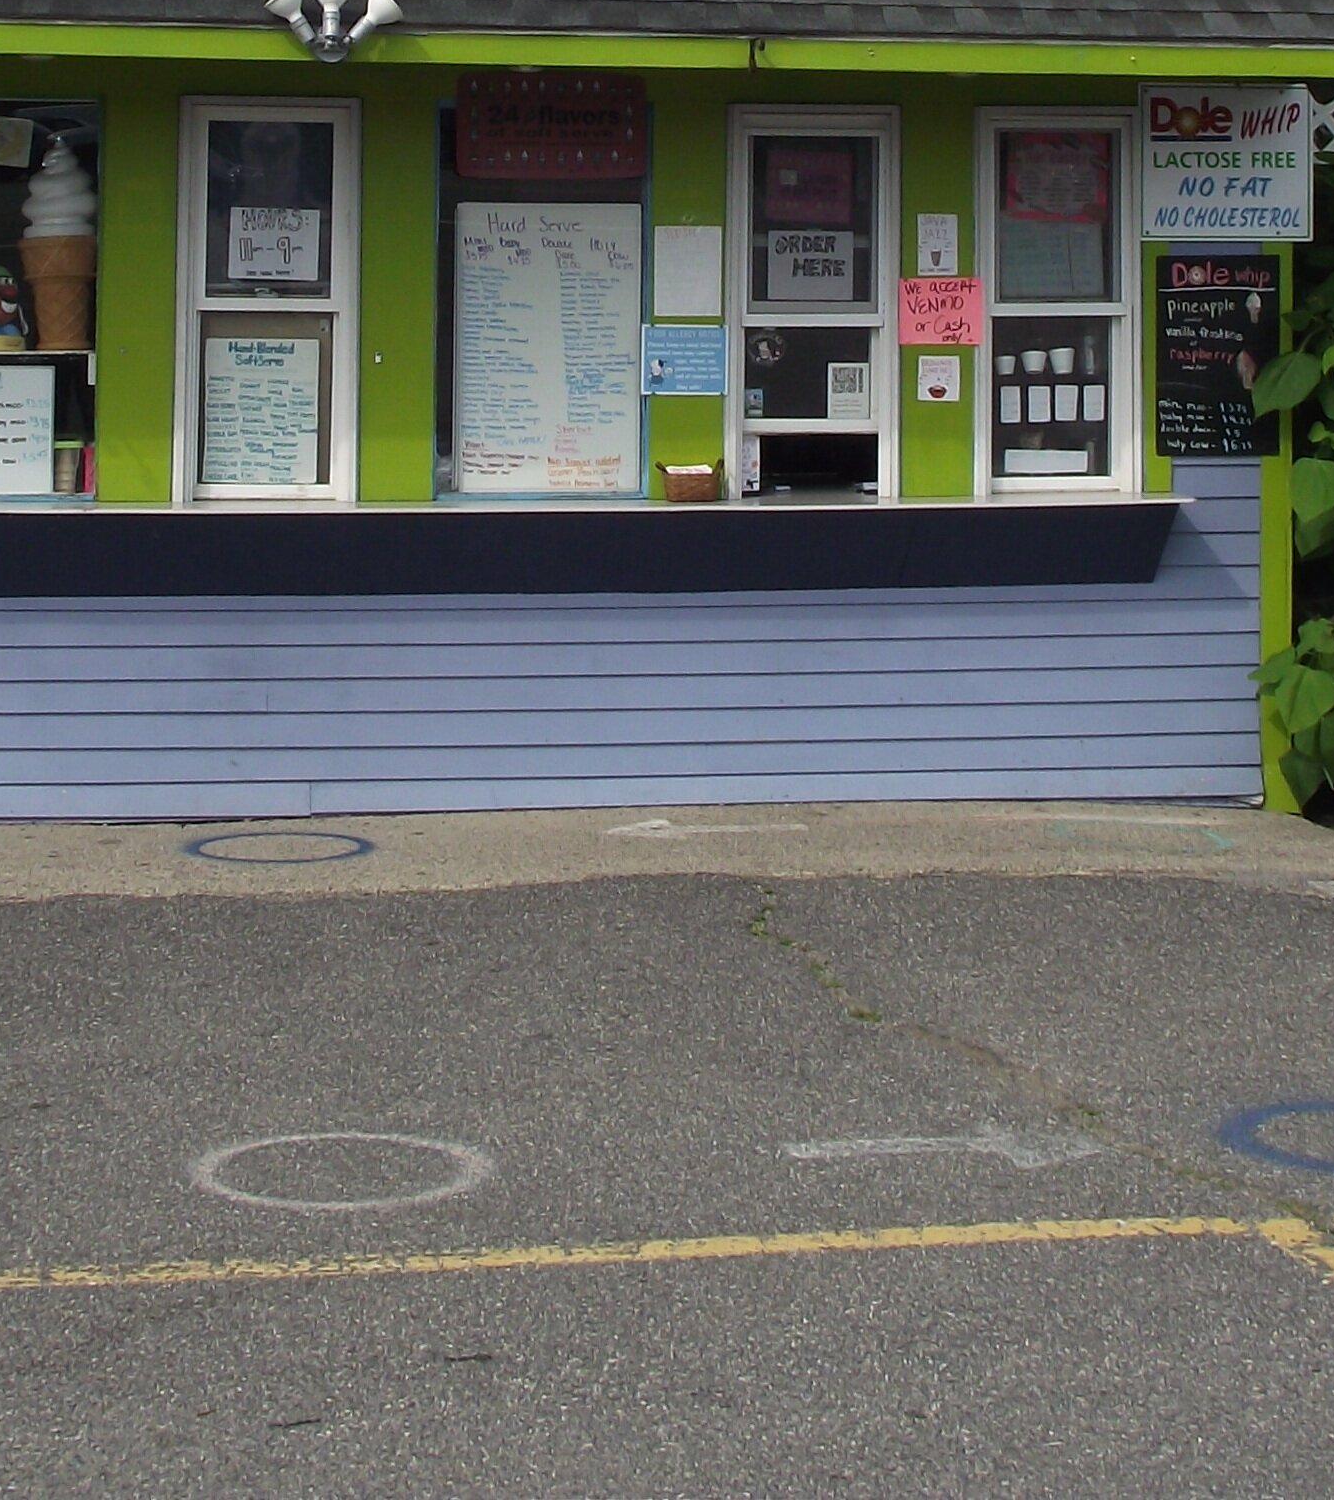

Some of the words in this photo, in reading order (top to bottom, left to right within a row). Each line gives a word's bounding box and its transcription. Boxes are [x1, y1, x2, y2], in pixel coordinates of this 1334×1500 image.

[1150, 97, 1233, 137] Dole
[1240, 103, 1301, 140] WHIP
[1153, 151, 1241, 169] LACTOSE
[1251, 151, 1296, 169] FREE
[1178, 176, 1215, 197] NO
[1223, 177, 1273, 198] FAT
[487, 212, 525, 234] Hard
[539, 215, 584, 233] Serve
[1154, 206, 1179, 228] NO
[1184, 206, 1301, 228] CHOLESTEROL
[775, 235, 836, 255] ORDER
[792, 258, 846, 277] HERE
[1172, 260, 1230, 287] Dole
[1235, 266, 1271, 288] whip
[907, 295, 964, 315] VENMO
[1167, 298, 1235, 320] pineapple
[915, 321, 931, 332] or
[1170, 347, 1234, 364] raspberry
